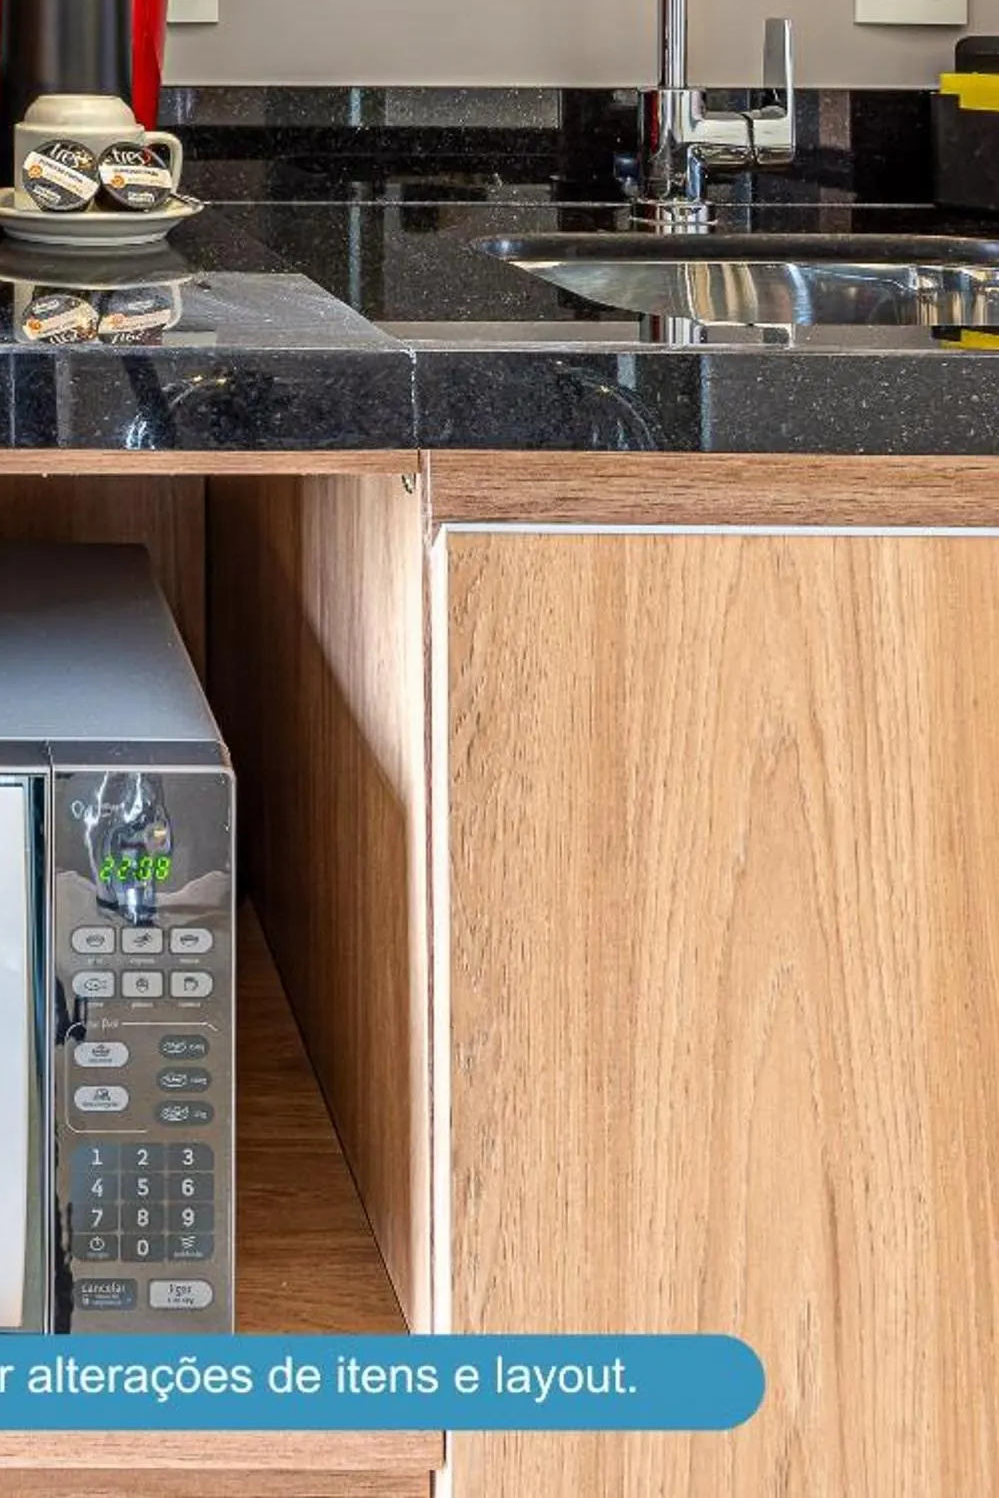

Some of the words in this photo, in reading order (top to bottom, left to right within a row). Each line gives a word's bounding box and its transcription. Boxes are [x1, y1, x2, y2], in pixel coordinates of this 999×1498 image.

[92, 1148, 103, 1166] 1
[137, 1148, 149, 1166] 2
[182, 1148, 194, 1165] 3
[91, 1178, 103, 1197] 4
[137, 1178, 149, 1196] 5
[182, 1178, 195, 1197] 6
[91, 1208, 103, 1227] 7
[137, 1208, 149, 1227] 8
[182, 1208, 195, 1227] 9
[137, 1239, 149, 1256] 0
